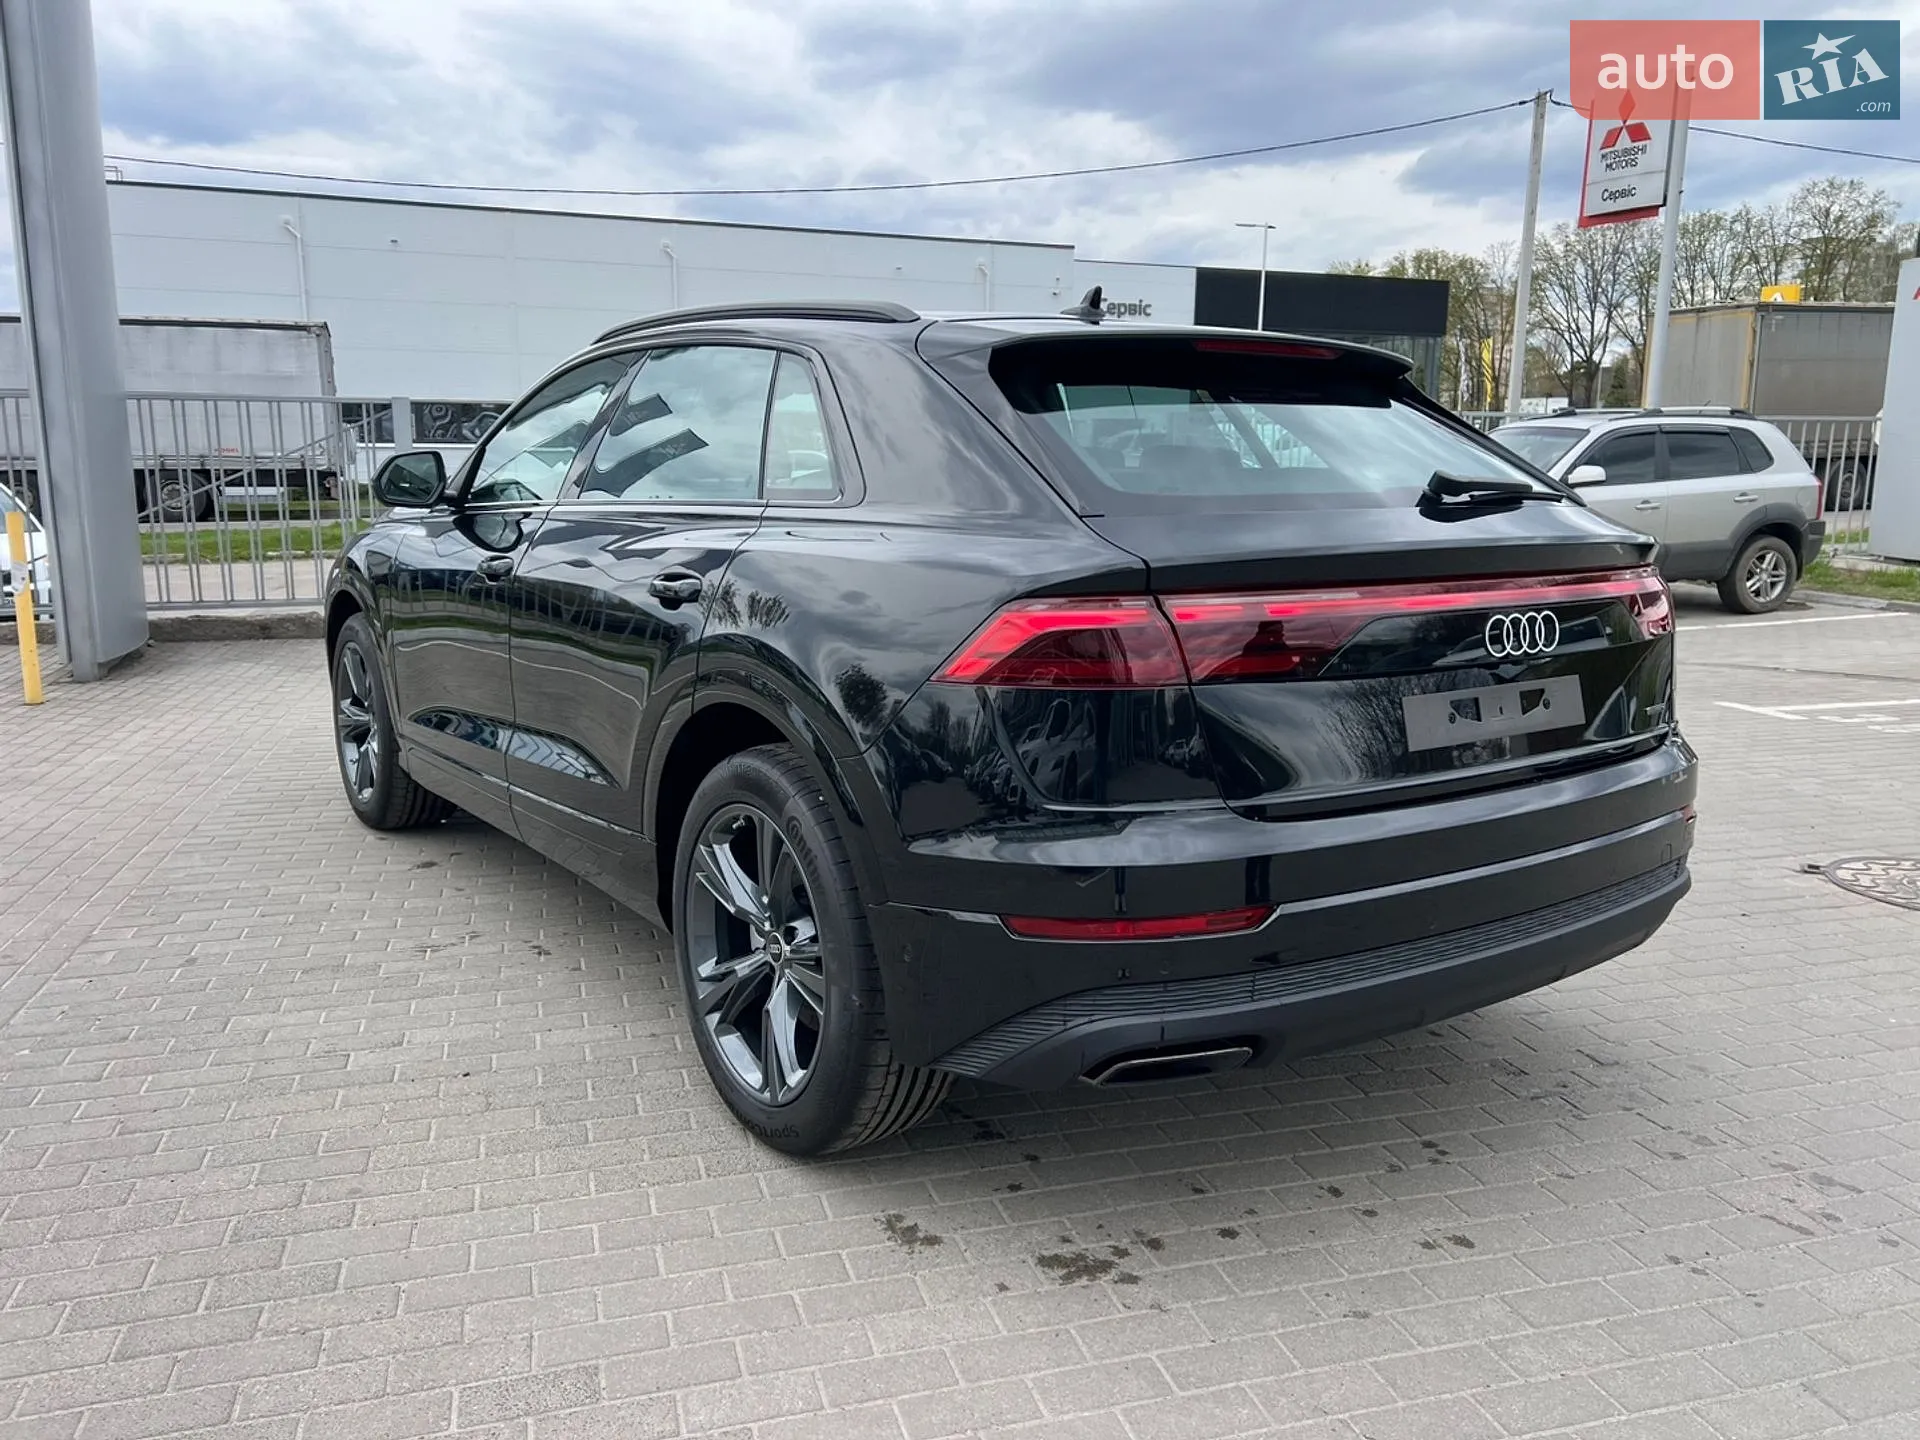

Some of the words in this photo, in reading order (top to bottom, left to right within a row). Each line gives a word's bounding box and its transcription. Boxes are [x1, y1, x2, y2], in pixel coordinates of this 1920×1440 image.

[1601, 144, 1648, 162] MITSUBISHI
[1605, 157, 1639, 172] MOTORS
[1601, 184, 1637, 203] Сервіс
